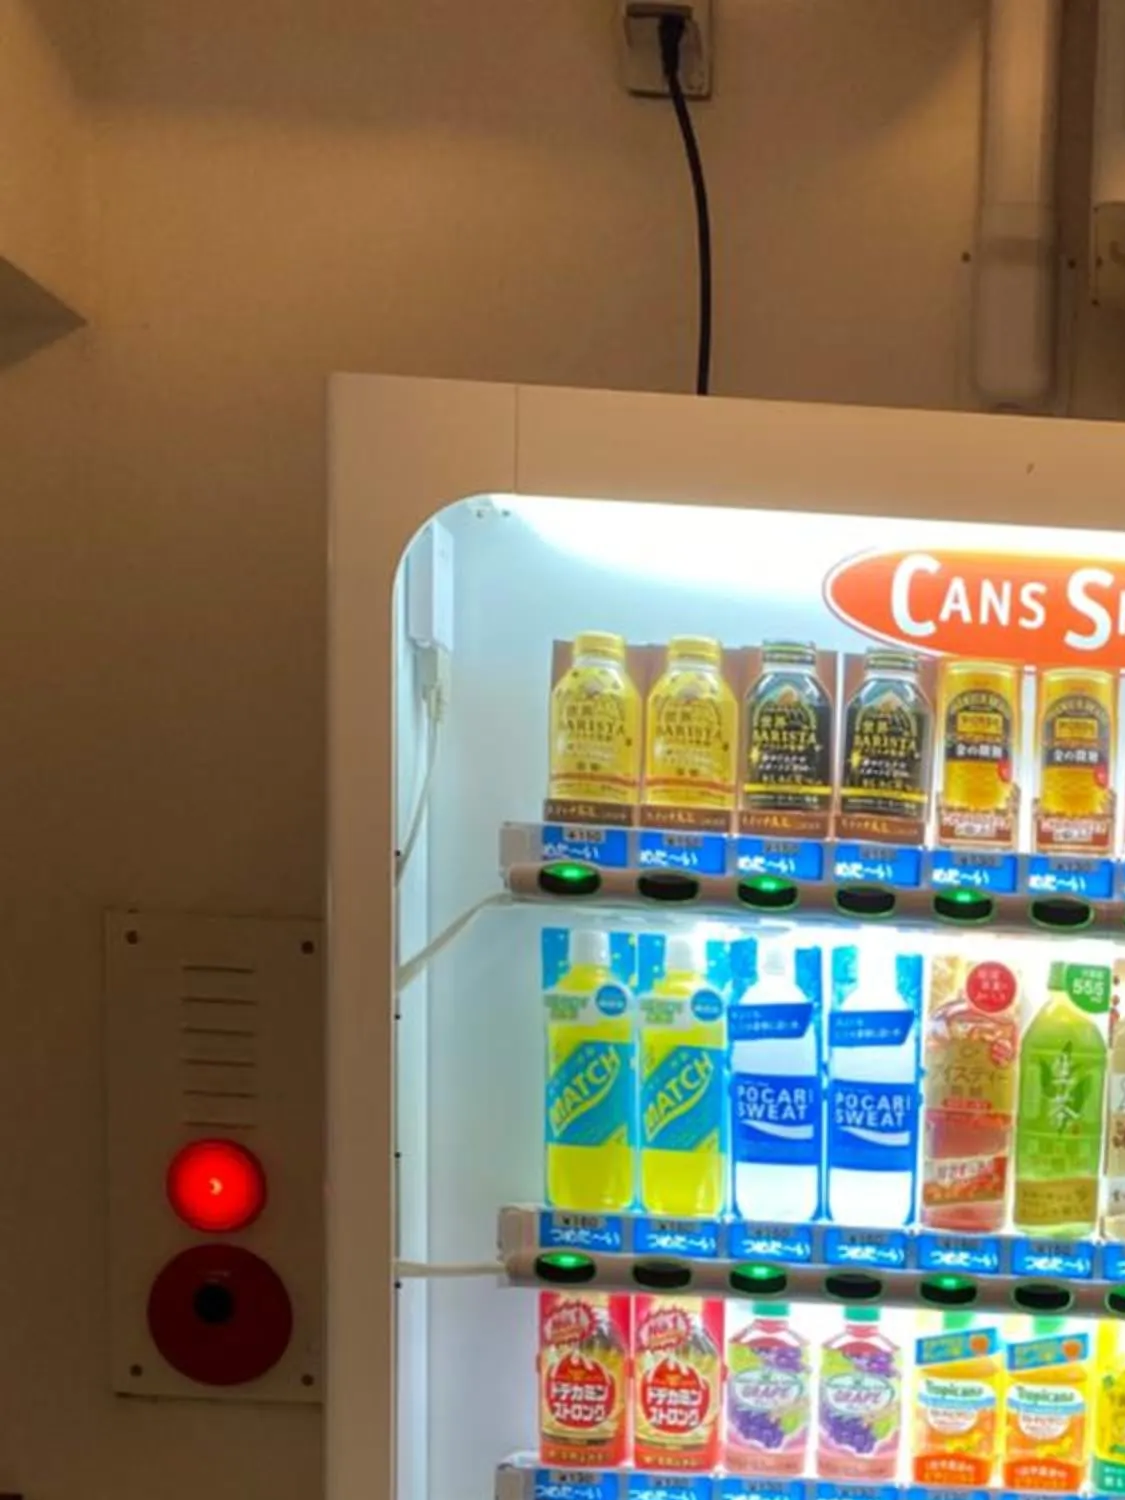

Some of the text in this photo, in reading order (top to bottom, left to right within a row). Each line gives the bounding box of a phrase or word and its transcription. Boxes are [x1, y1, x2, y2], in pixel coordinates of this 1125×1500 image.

[890, 553, 1048, 638] CANS
[736, 1084, 814, 1106] POCARI
[834, 1090, 911, 1112] POCARI
[737, 1101, 808, 1121] SWEAT
[835, 1108, 905, 1128] SWEAT
